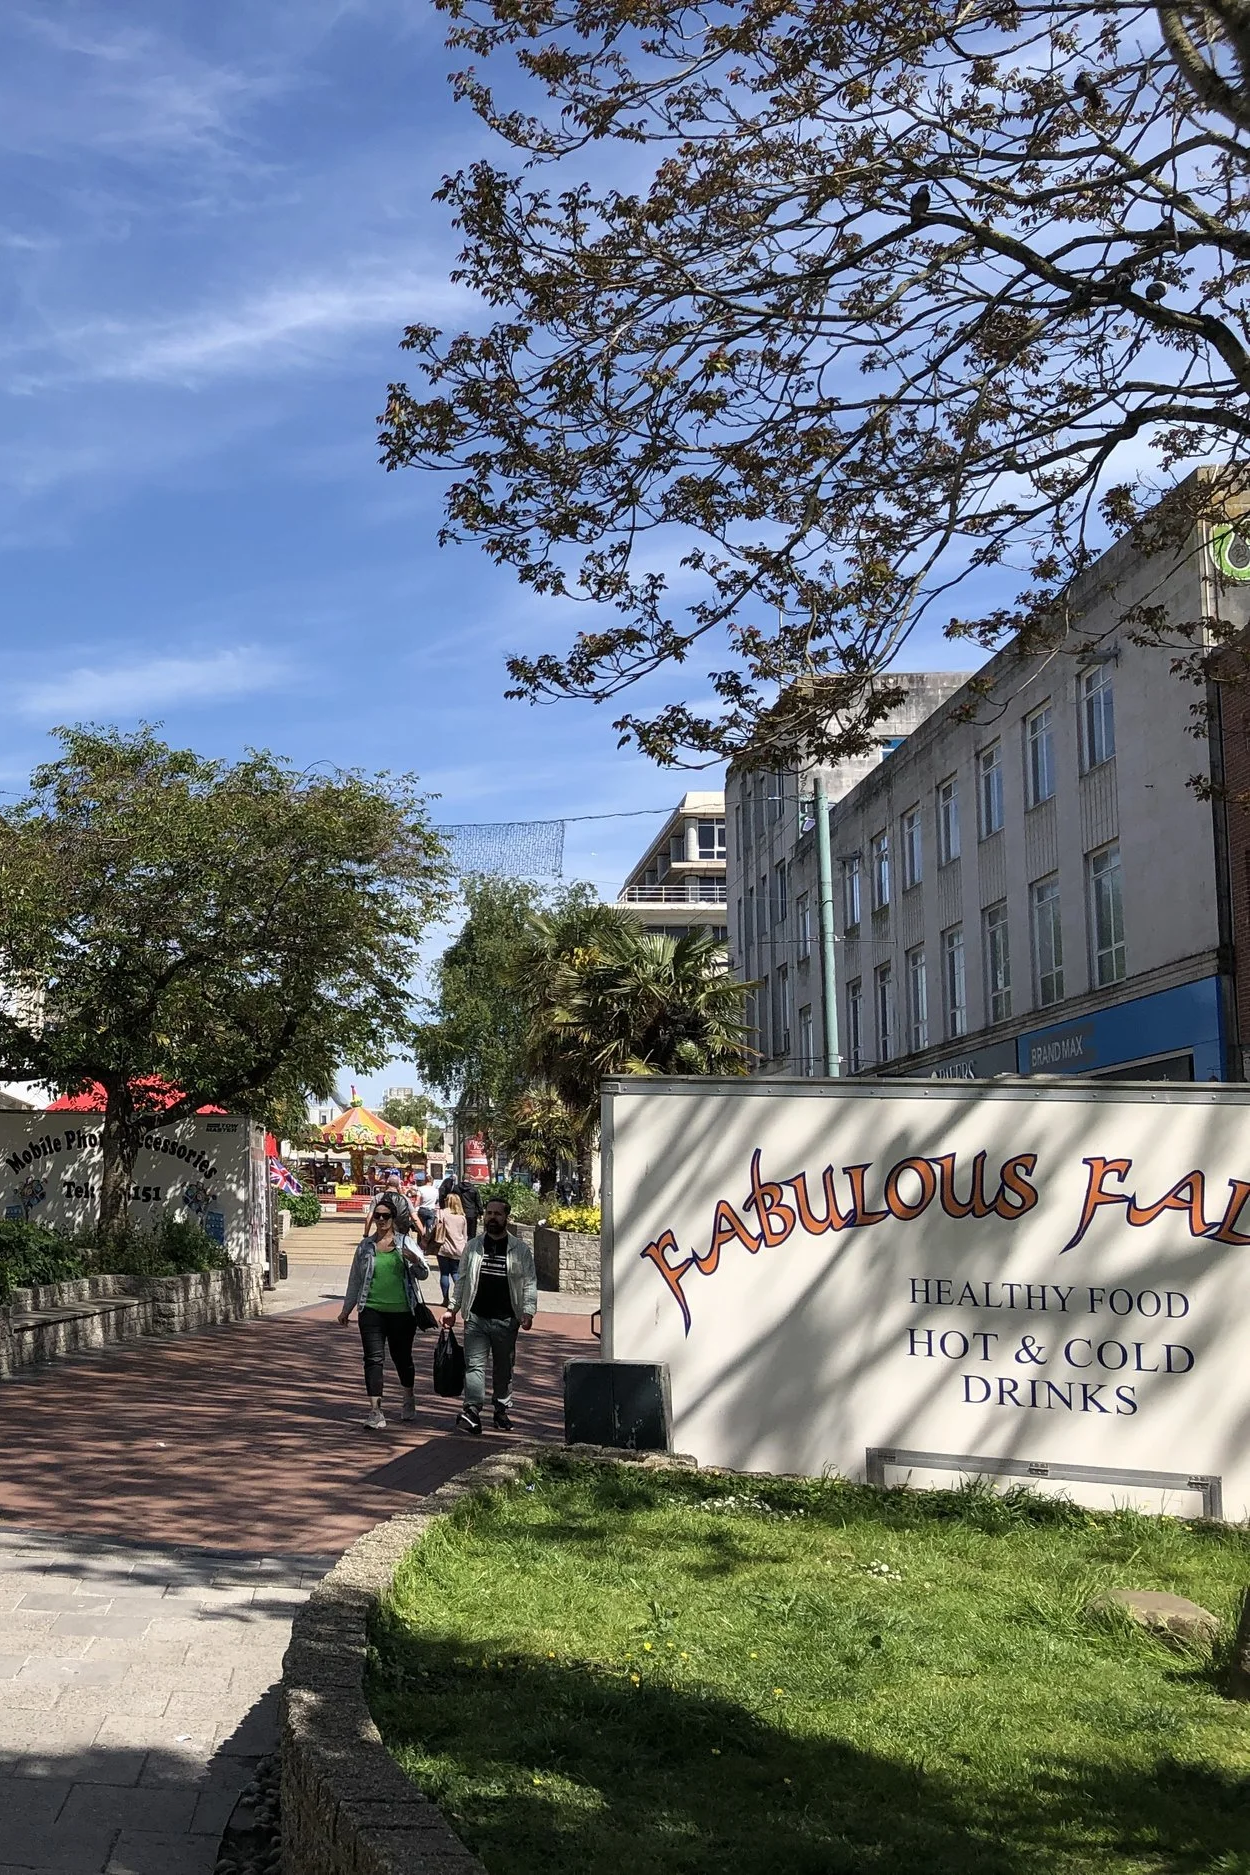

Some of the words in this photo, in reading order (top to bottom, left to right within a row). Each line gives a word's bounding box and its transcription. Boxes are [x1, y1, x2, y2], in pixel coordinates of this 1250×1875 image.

[6, 1138, 62, 1175] Mobile
[128, 1186, 161, 1202] 151
[640, 1148, 1039, 1340] FABULOUS
[909, 1277, 1075, 1313] HEALTHY
[1086, 1287, 1190, 1318] FOOD
[906, 1328, 999, 1362] HOT
[1014, 1335, 1048, 1365] &
[1063, 1338, 1195, 1374] COLD
[961, 1374, 1138, 1415] DRINKS
